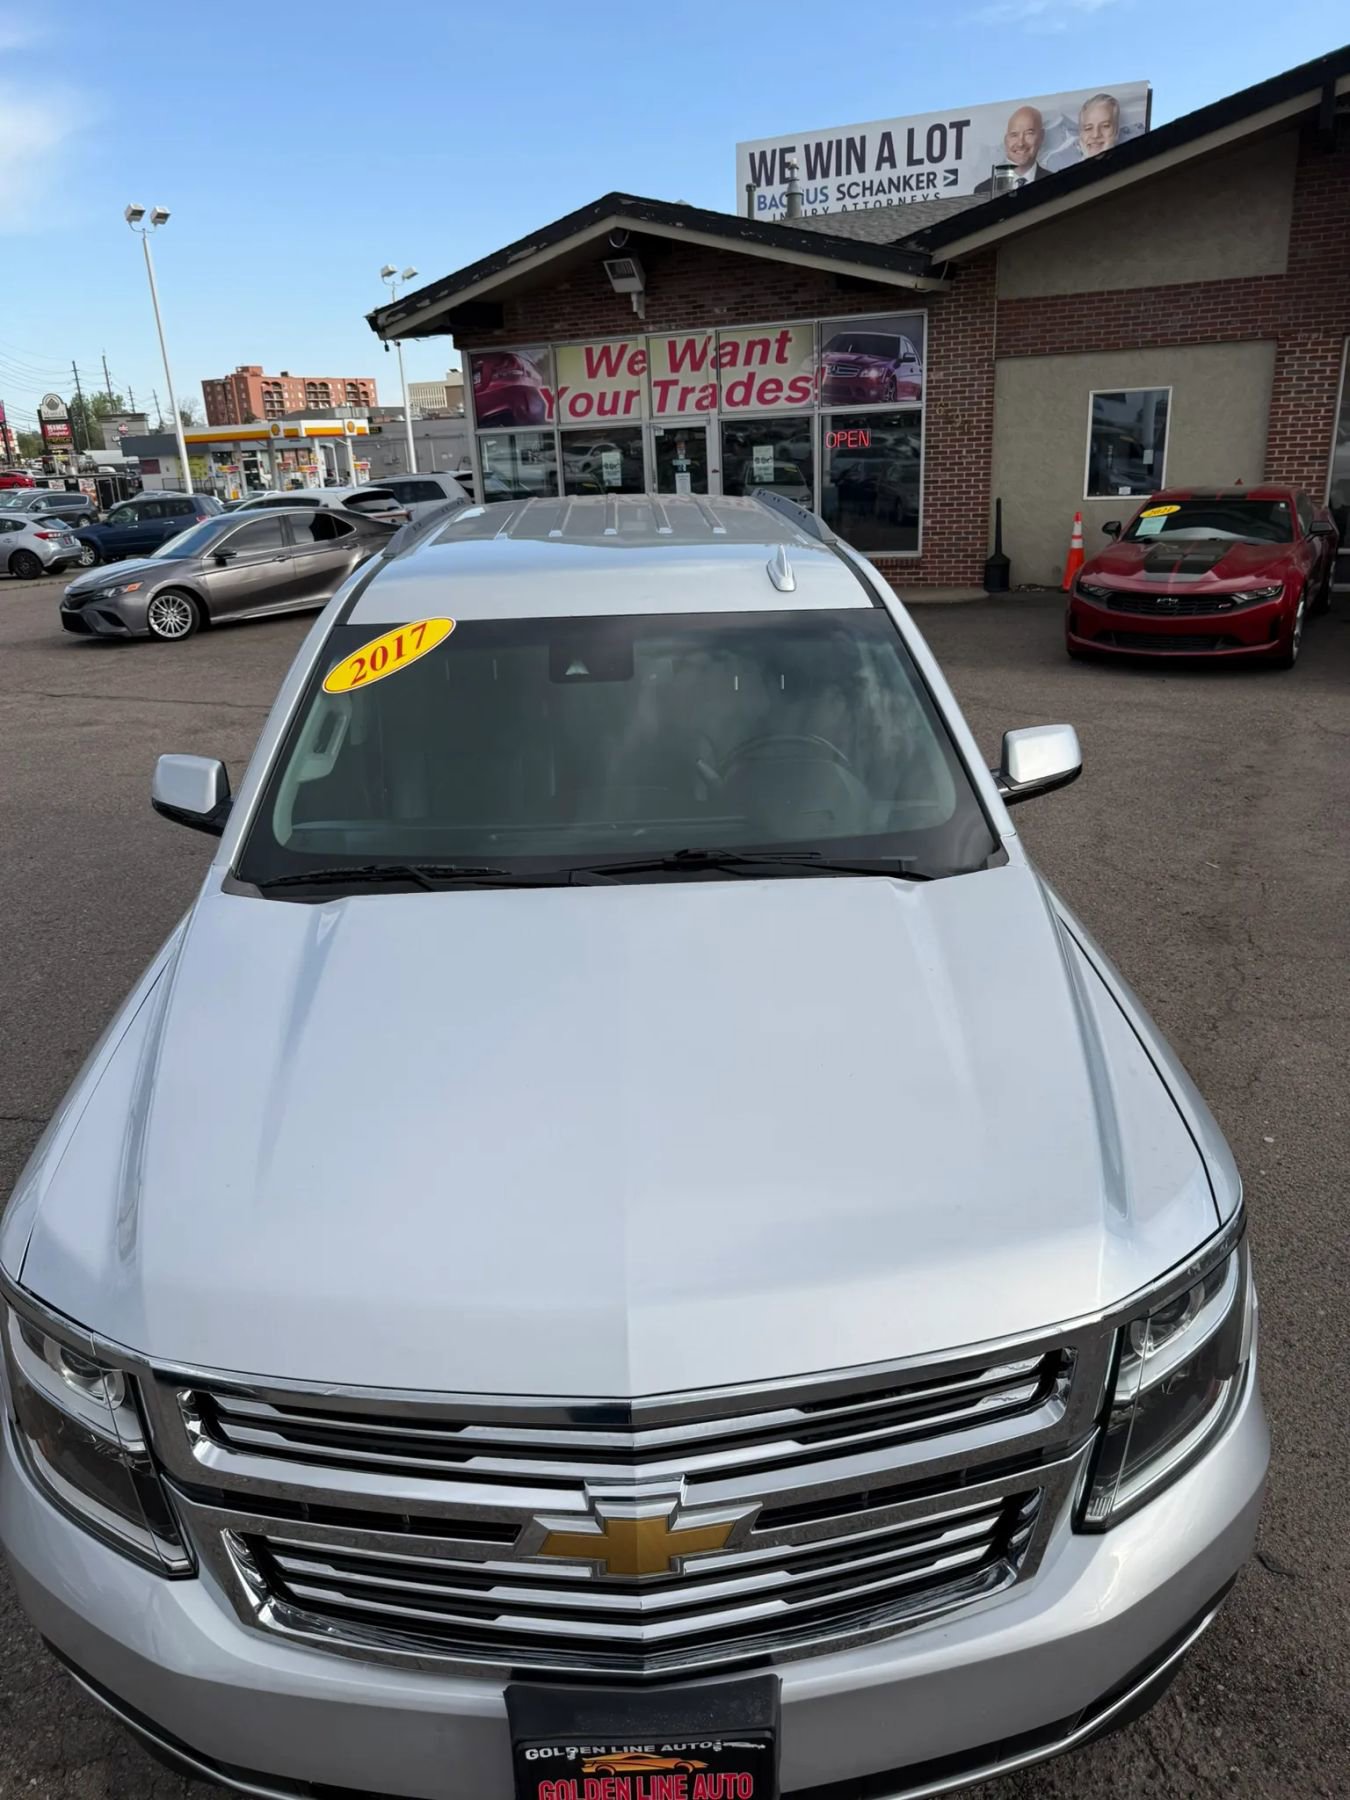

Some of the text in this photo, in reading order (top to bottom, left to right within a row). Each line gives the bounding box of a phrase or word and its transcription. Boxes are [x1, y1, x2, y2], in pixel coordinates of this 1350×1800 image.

[749, 119, 971, 187] WE WIN A LOT
[836, 171, 938, 201] SCHANKER
[583, 329, 793, 380] We Want
[540, 366, 828, 420] Your Trades!
[825, 430, 870, 448] OPEN
[349, 622, 428, 686] 2017
[525, 1746, 606, 1761] GOLDEN
[611, 1744, 655, 1754] LINE
[538, 1771, 754, 1800] GOLDEN LINE AUTO
